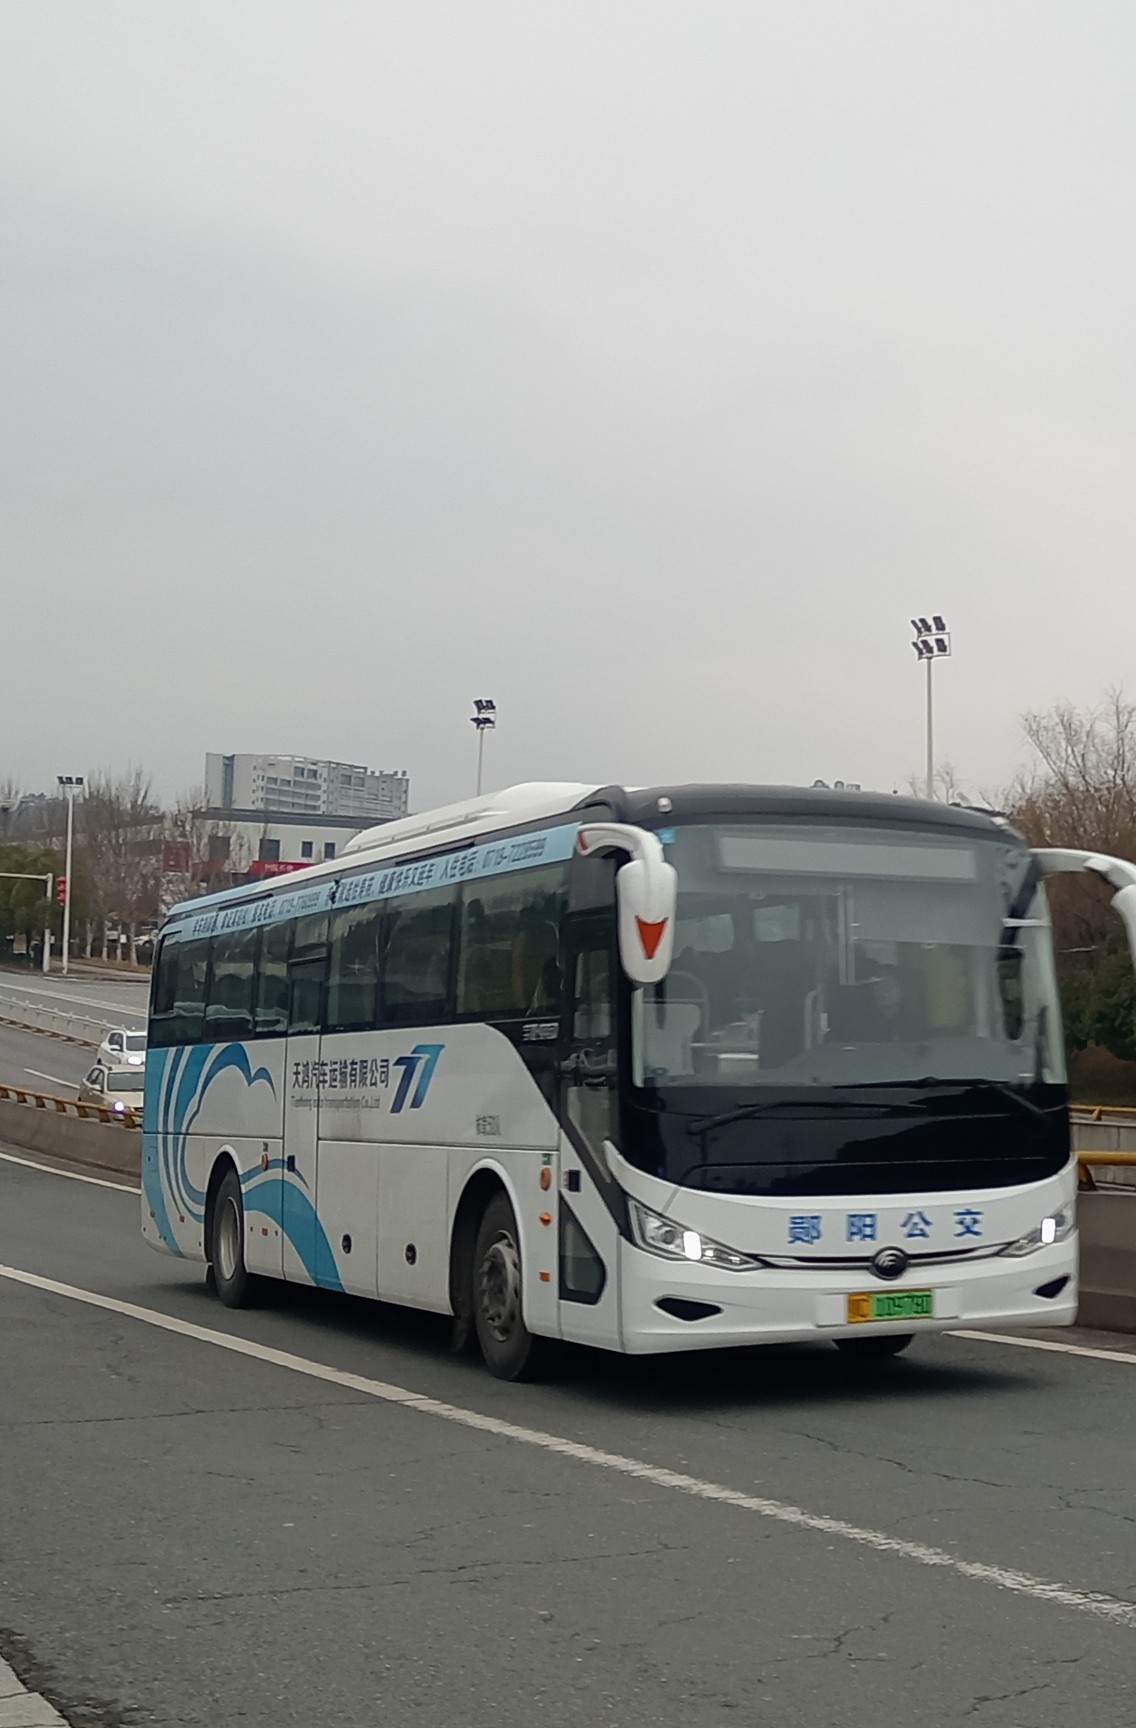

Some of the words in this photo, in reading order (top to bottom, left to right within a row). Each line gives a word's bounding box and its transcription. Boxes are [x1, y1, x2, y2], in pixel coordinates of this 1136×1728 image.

[292, 1059, 390, 1089] 天鸿汽车运输有限公司
